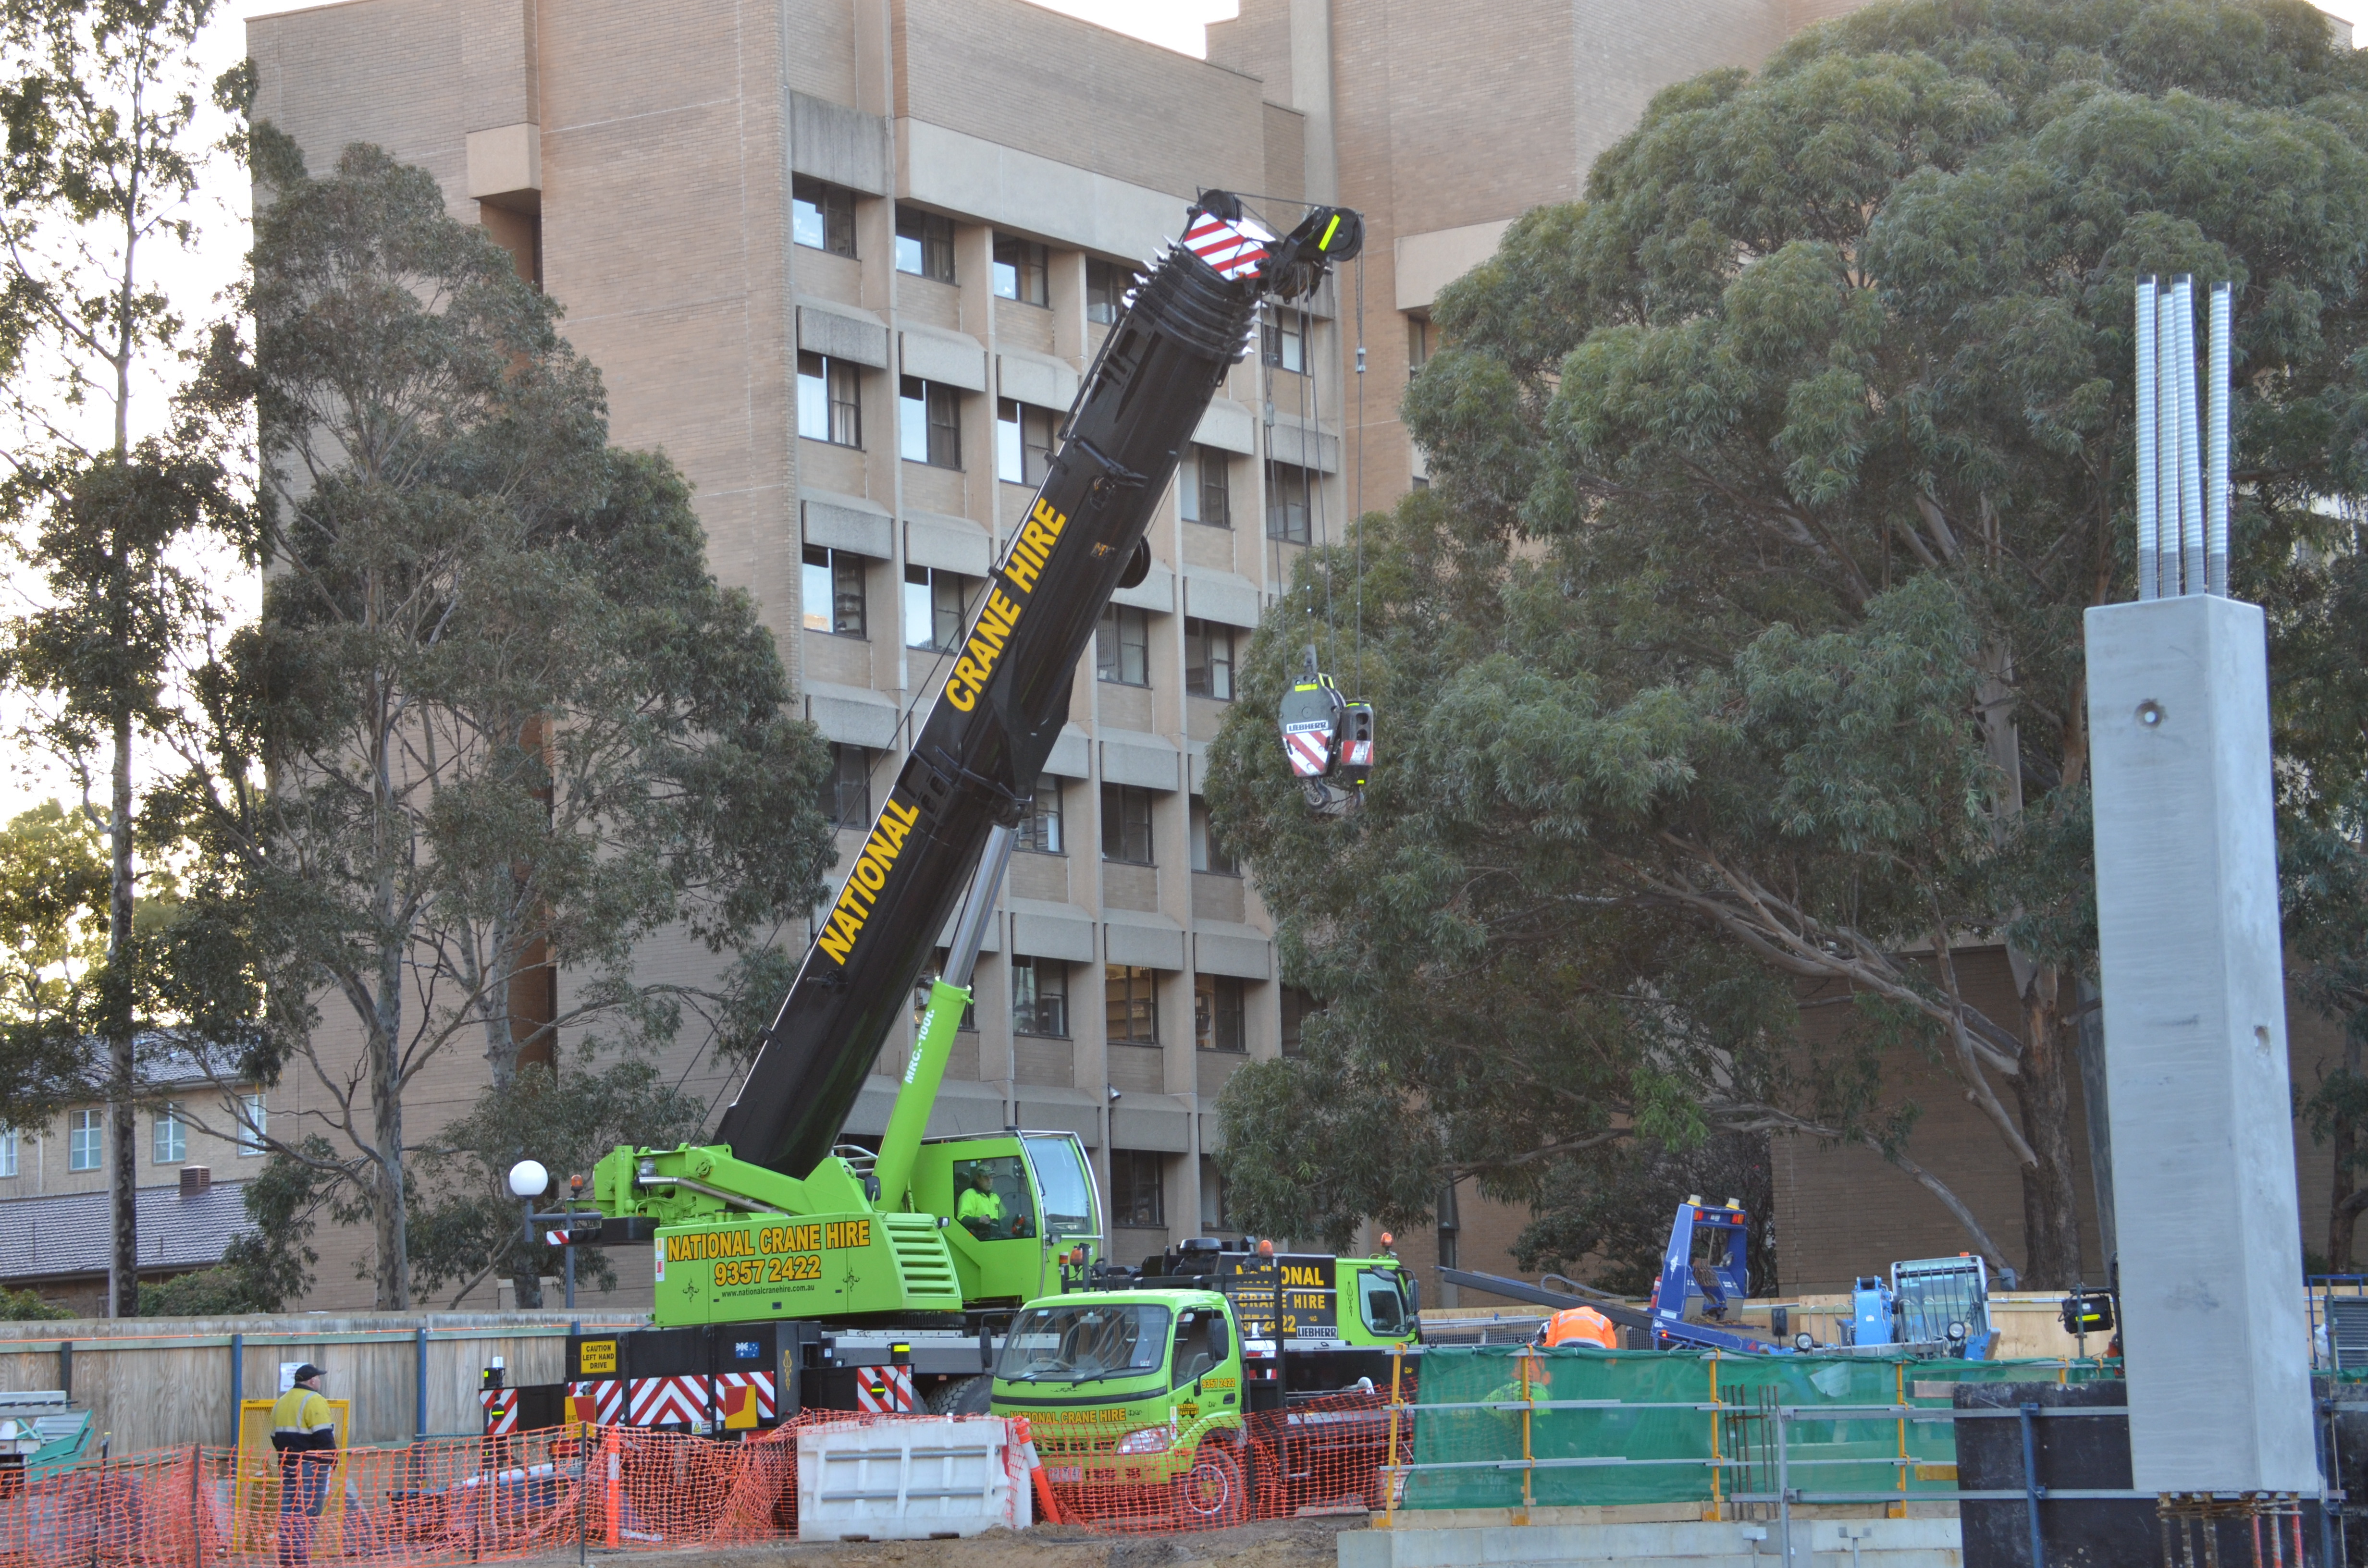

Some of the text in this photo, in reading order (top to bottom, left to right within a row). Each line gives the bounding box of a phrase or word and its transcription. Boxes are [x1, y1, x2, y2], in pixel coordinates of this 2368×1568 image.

[818, 497, 1066, 965] NATIONAL CRANE HIRE
[1289, 722, 1326, 731] LIEBHERR
[667, 1230, 755, 1262] NATIONAL
[759, 1224, 821, 1254] CRANE
[826, 1220, 870, 1249] HIRE
[714, 1255, 821, 1286] 9357 2422
[722, 1284, 814, 1297] www.nationalcranehire.com.au
[1294, 1294, 1325, 1309] HIRE
[1298, 1328, 1337, 1337] LIEBHERR
[1202, 1378, 1235, 1388] 9357 2422
[1061, 1410, 1097, 1424] CRANE
[1099, 1409, 1126, 1422] HIRE
